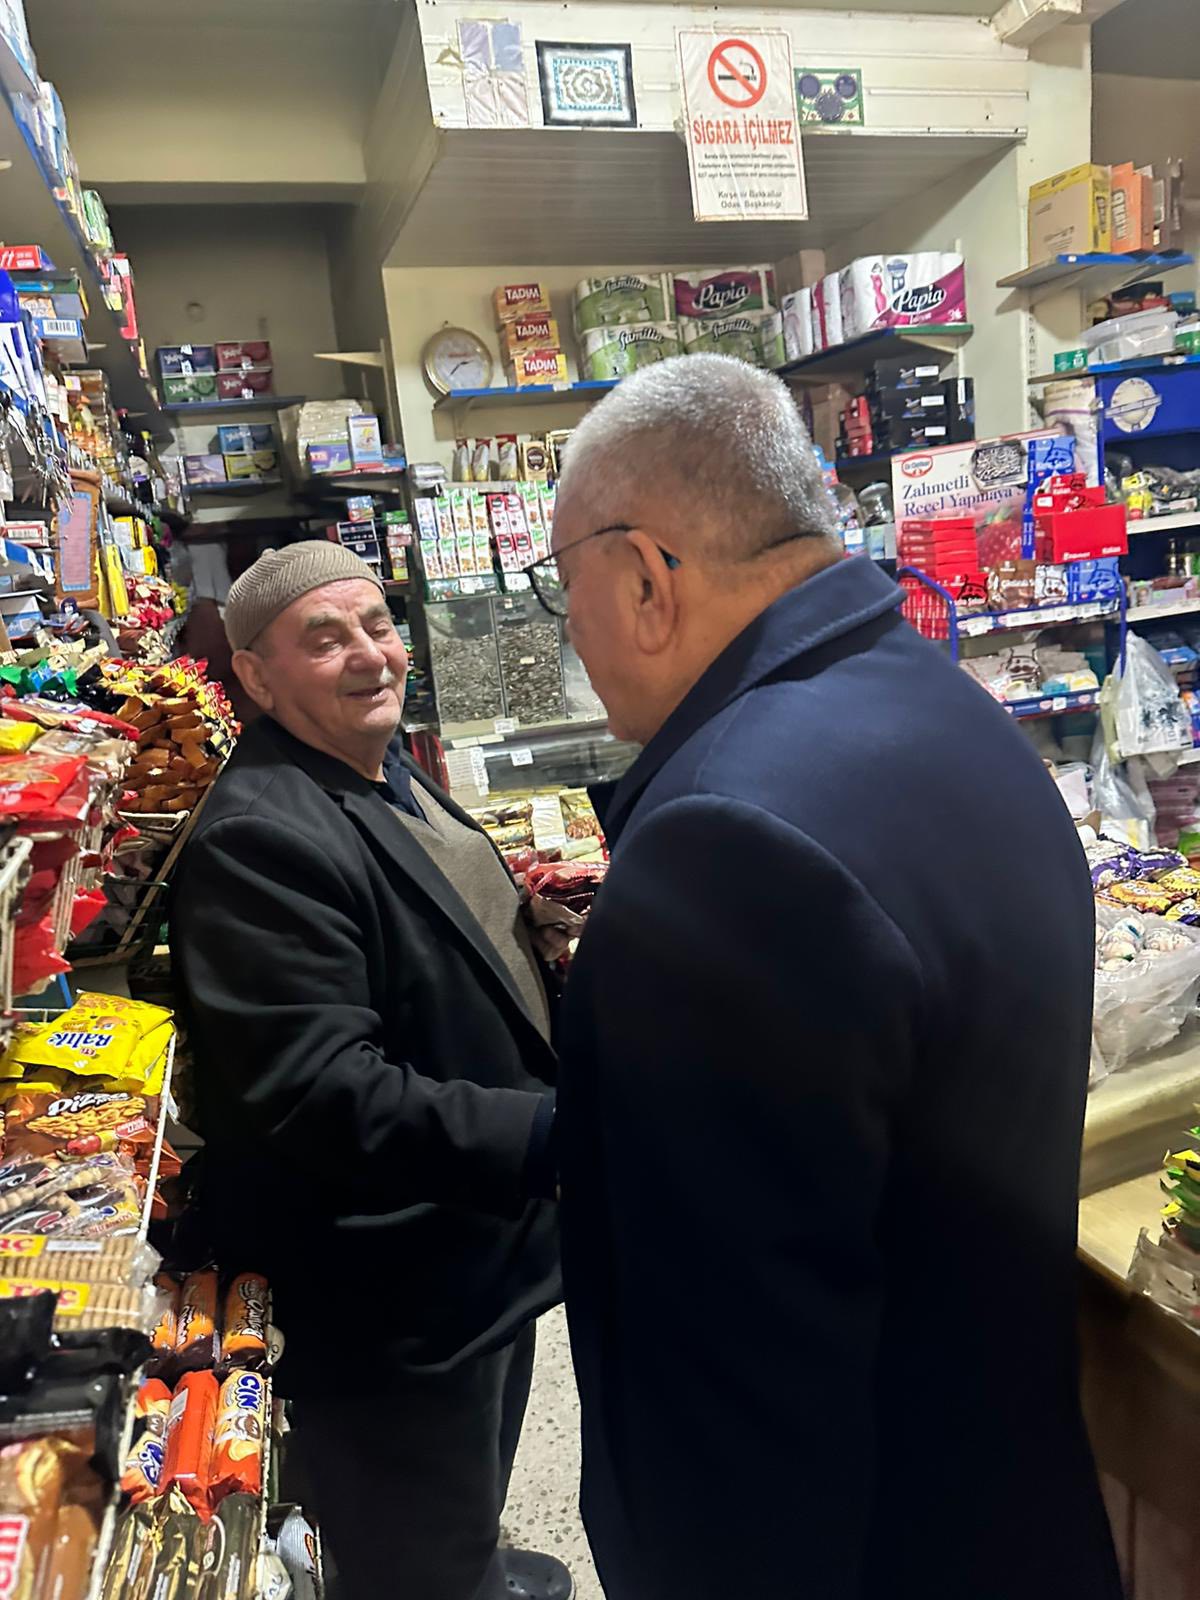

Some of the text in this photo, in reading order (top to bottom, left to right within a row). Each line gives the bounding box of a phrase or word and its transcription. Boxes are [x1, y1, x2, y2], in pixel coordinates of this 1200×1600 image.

[693, 114, 794, 151] SİGARA İÇİLMEZ
[505, 286, 540, 300] TADIM
[605, 275, 647, 297] familia
[698, 281, 748, 311] Papia
[897, 284, 943, 313] Papia
[516, 324, 549, 337] TADIM
[619, 327, 665, 350] familia
[712, 318, 757, 342] familia
[524, 359, 558, 371] TADIM
[903, 475, 969, 499] Zahmetli
[950, 488, 1012, 509] Yapmaya
